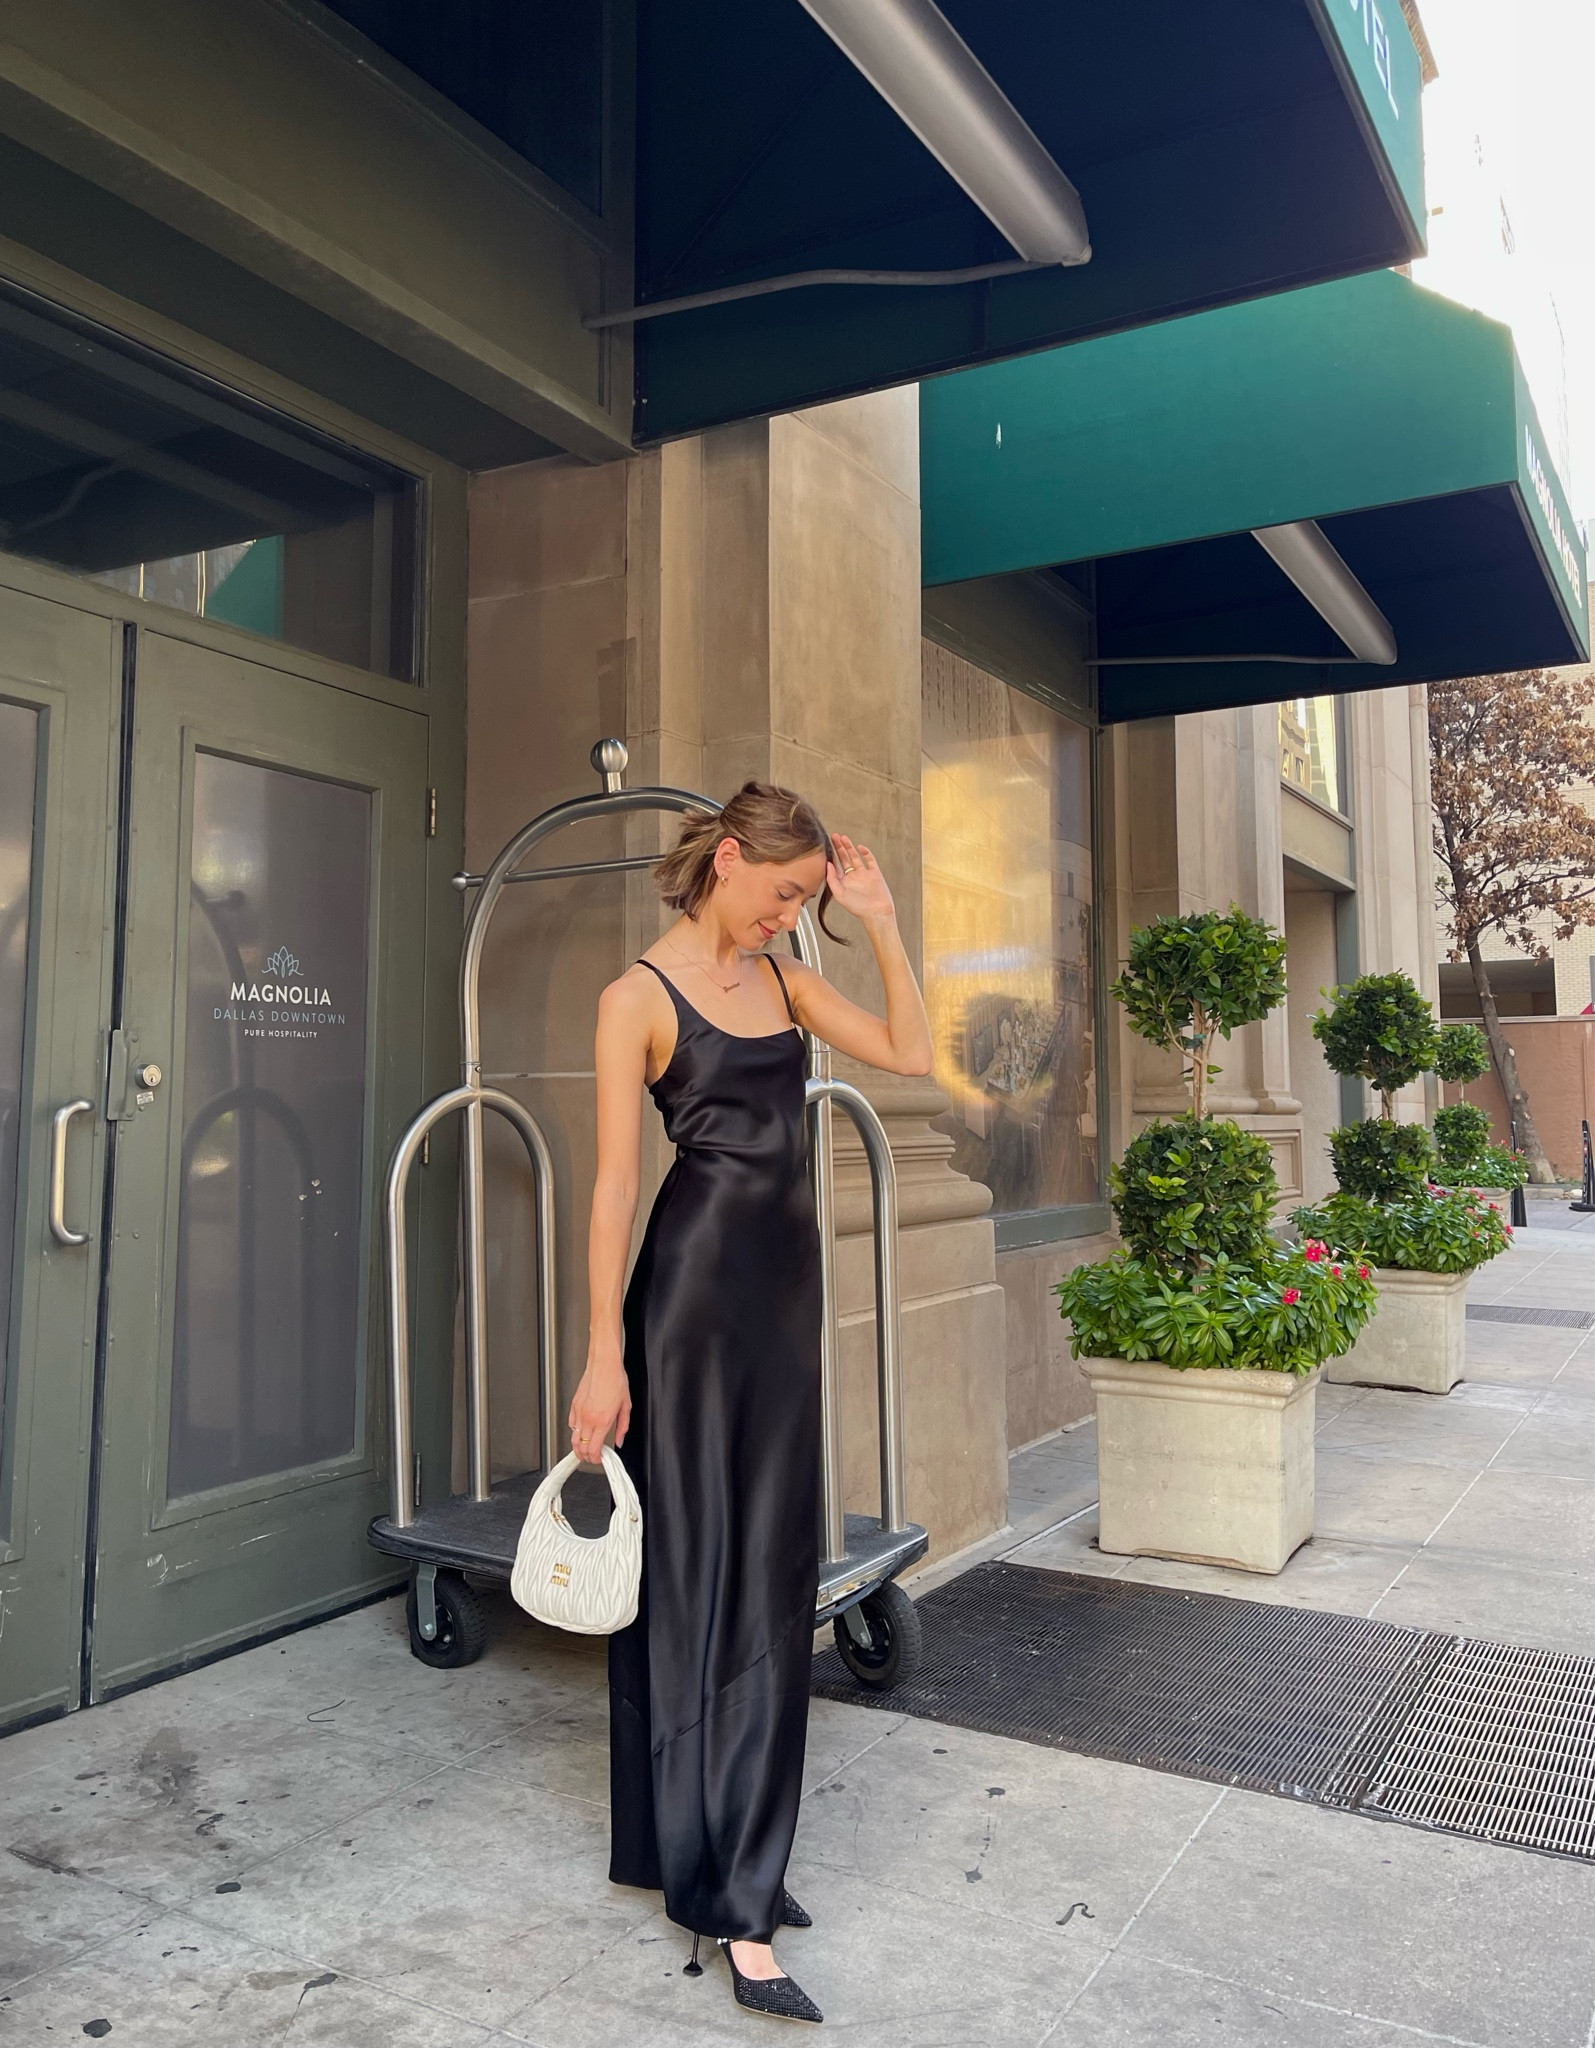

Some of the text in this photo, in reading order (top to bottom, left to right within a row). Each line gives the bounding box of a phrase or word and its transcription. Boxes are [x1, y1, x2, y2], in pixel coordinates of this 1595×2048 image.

[230, 982, 332, 1006] MAGNOLIA
[213, 1007, 346, 1025] DALLAS DOWNTOWN
[244, 1028, 318, 1038] PURE HOSPITALITY
